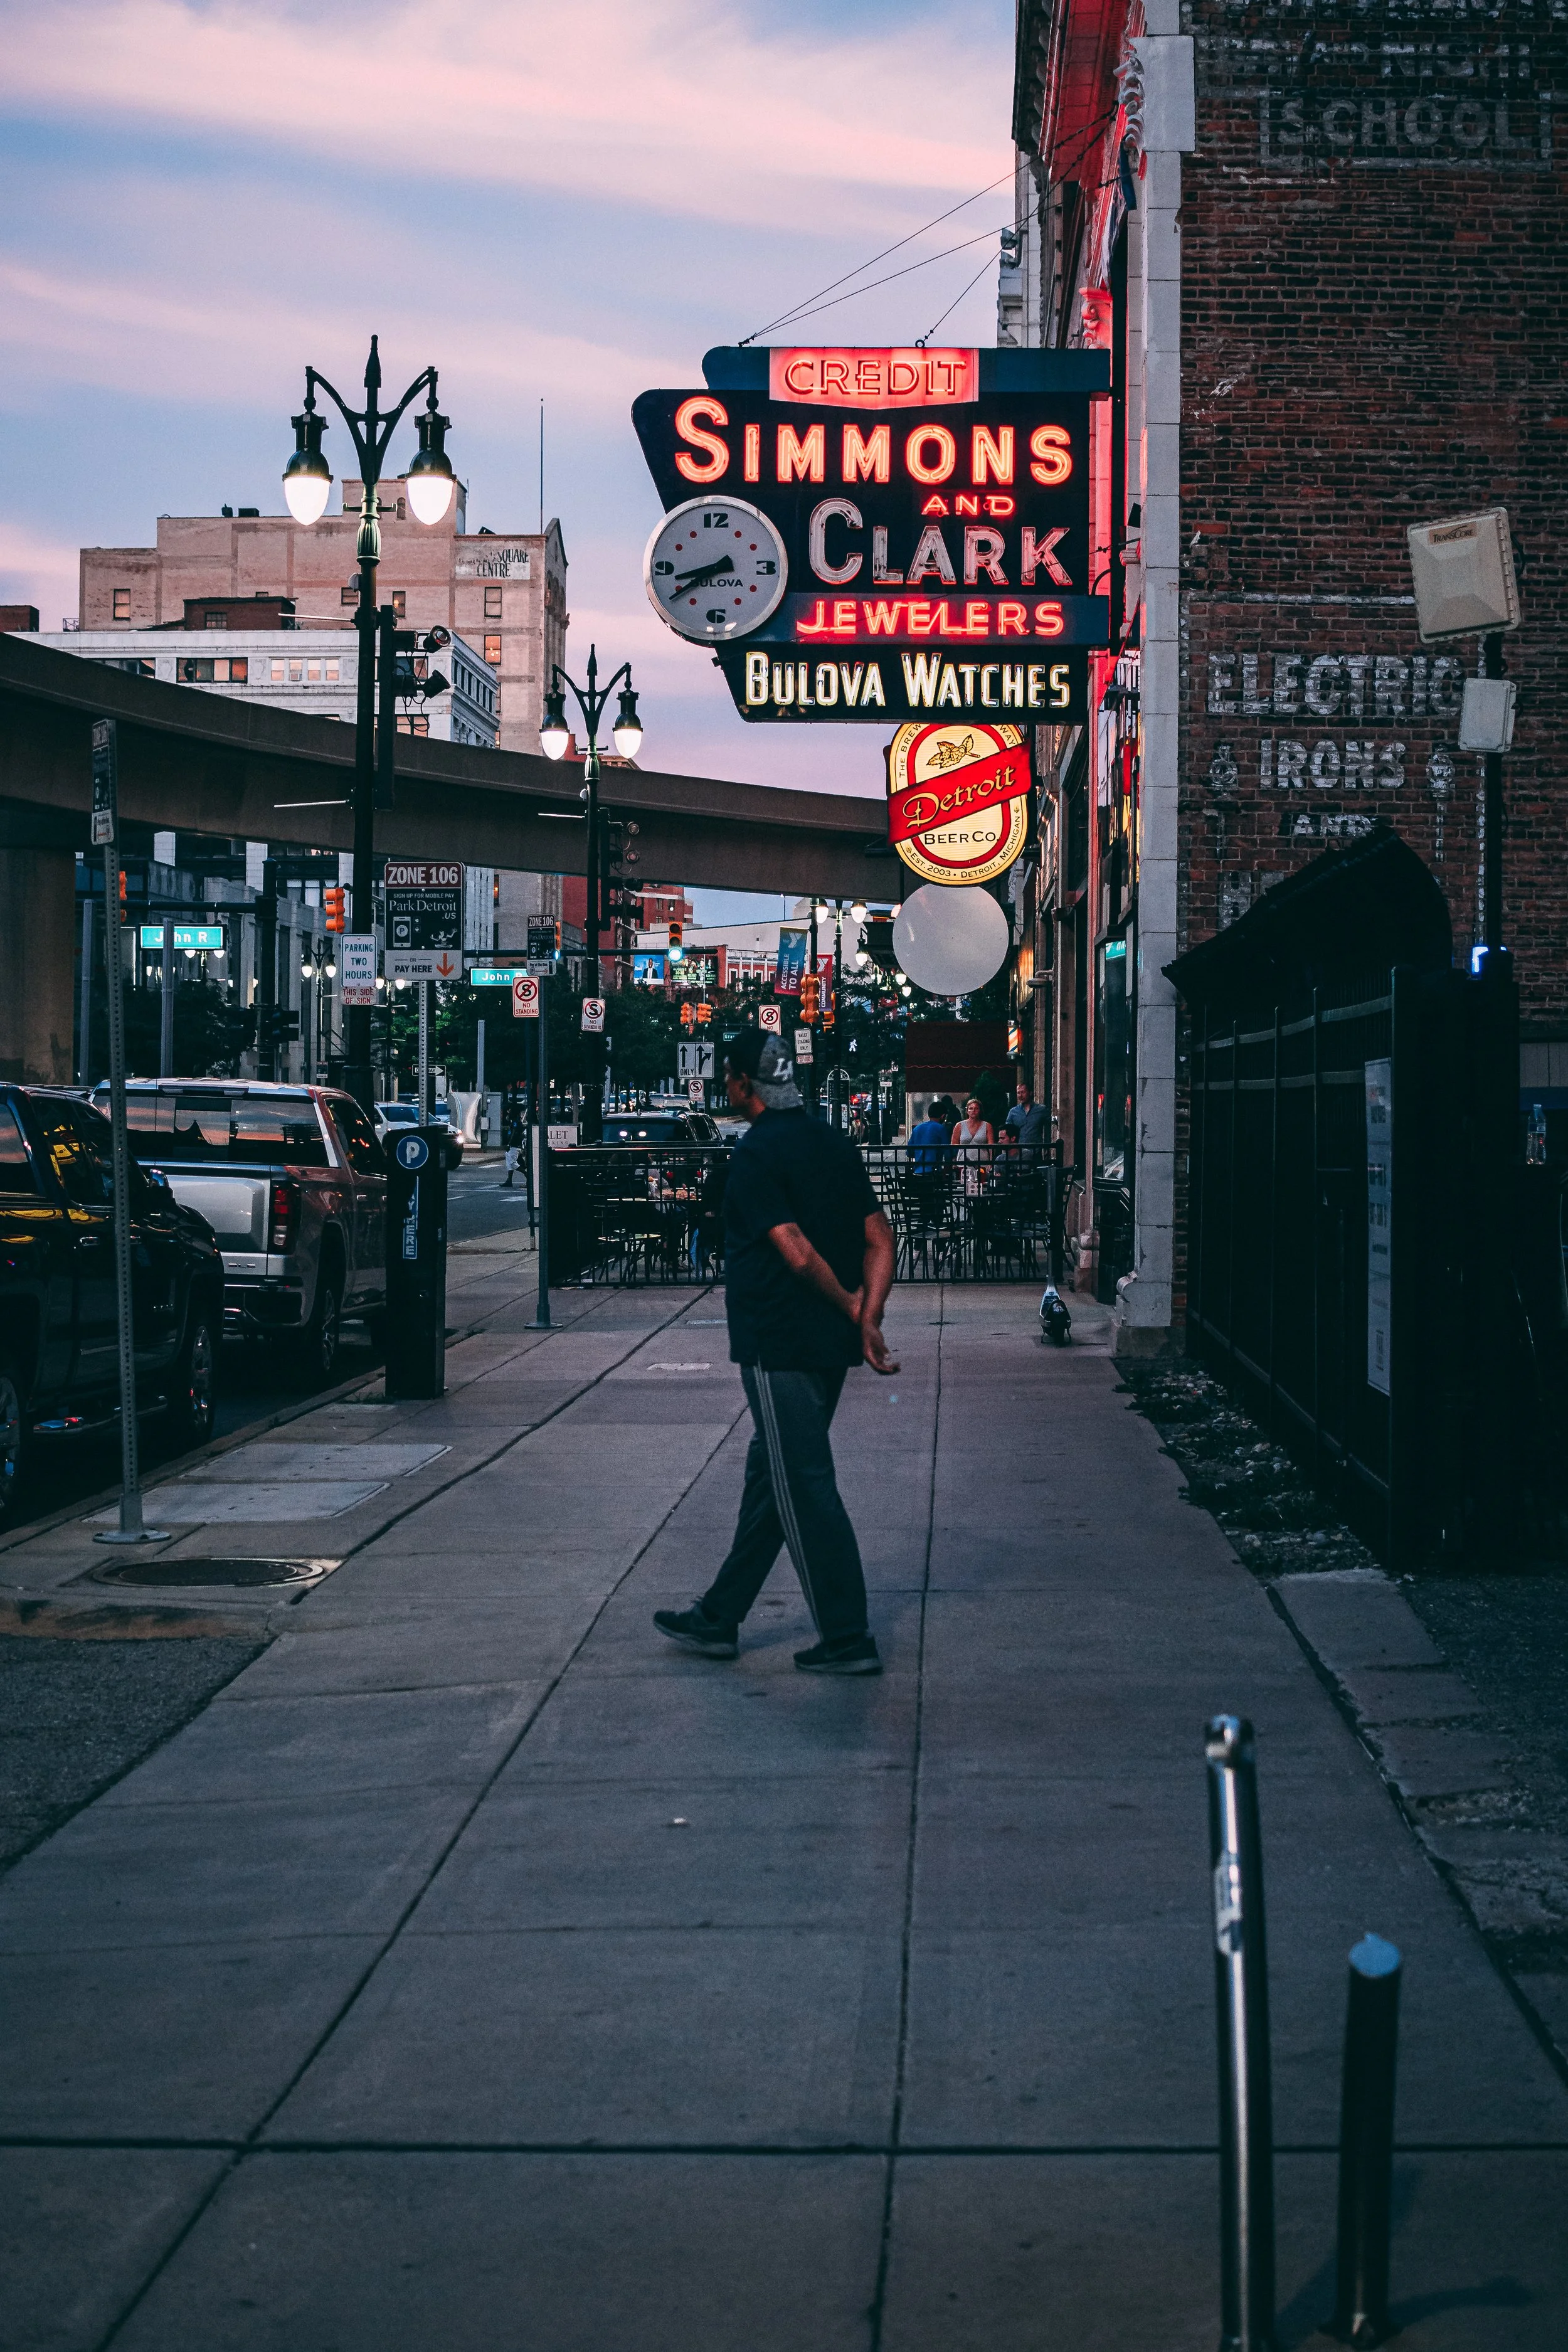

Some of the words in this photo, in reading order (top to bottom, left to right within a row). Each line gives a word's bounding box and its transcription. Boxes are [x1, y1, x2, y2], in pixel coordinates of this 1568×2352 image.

[1278, 98, 1533, 148] SCHOOL
[785, 359, 967, 396] CREDIT
[674, 396, 1073, 485] SIMMONS
[921, 495, 1014, 516] AND
[703, 513, 729, 528] 12
[810, 498, 1073, 585] CLARK
[497, 549, 529, 563] SQUARE
[477, 562, 511, 578] CENTRE
[655, 561, 675, 576] 9
[756, 560, 776, 575] 3
[706, 609, 726, 623] 6
[797, 600, 1064, 636] JEWELERS
[746, 652, 885, 707] BULOVA
[901, 653, 1070, 707] WATCHES
[1207, 654, 1465, 716] ELECTRIC
[901, 723, 923, 752] BREW
[1259, 739, 1407, 788] IRONS
[903, 765, 1016, 828] Detroit
[910, 852, 926, 869] EST.
[927, 865, 951, 877] 2003
[961, 861, 1000, 878] DETROIT,
[1000, 816, 1020, 861] MICHIGAN
[924, 833, 969, 845] BEER
[388, 867, 426, 884] ZONE
[430, 867, 458, 884] 106
[529, 916, 543, 926] ZONE
[543, 916, 553, 926] 106
[154, 931, 191, 943] Jhn
[198, 931, 208, 943] R
[345, 944, 373, 952] PARKING
[351, 958, 367, 966] TWO
[345, 971, 372, 979] HOURS
[482, 973, 509, 981] John
[780, 953, 790, 989] ACCESSIBLE
[789, 978, 797, 990] TO
[548, 1131, 568, 1139] LET
[406, 1142, 420, 1163] P
